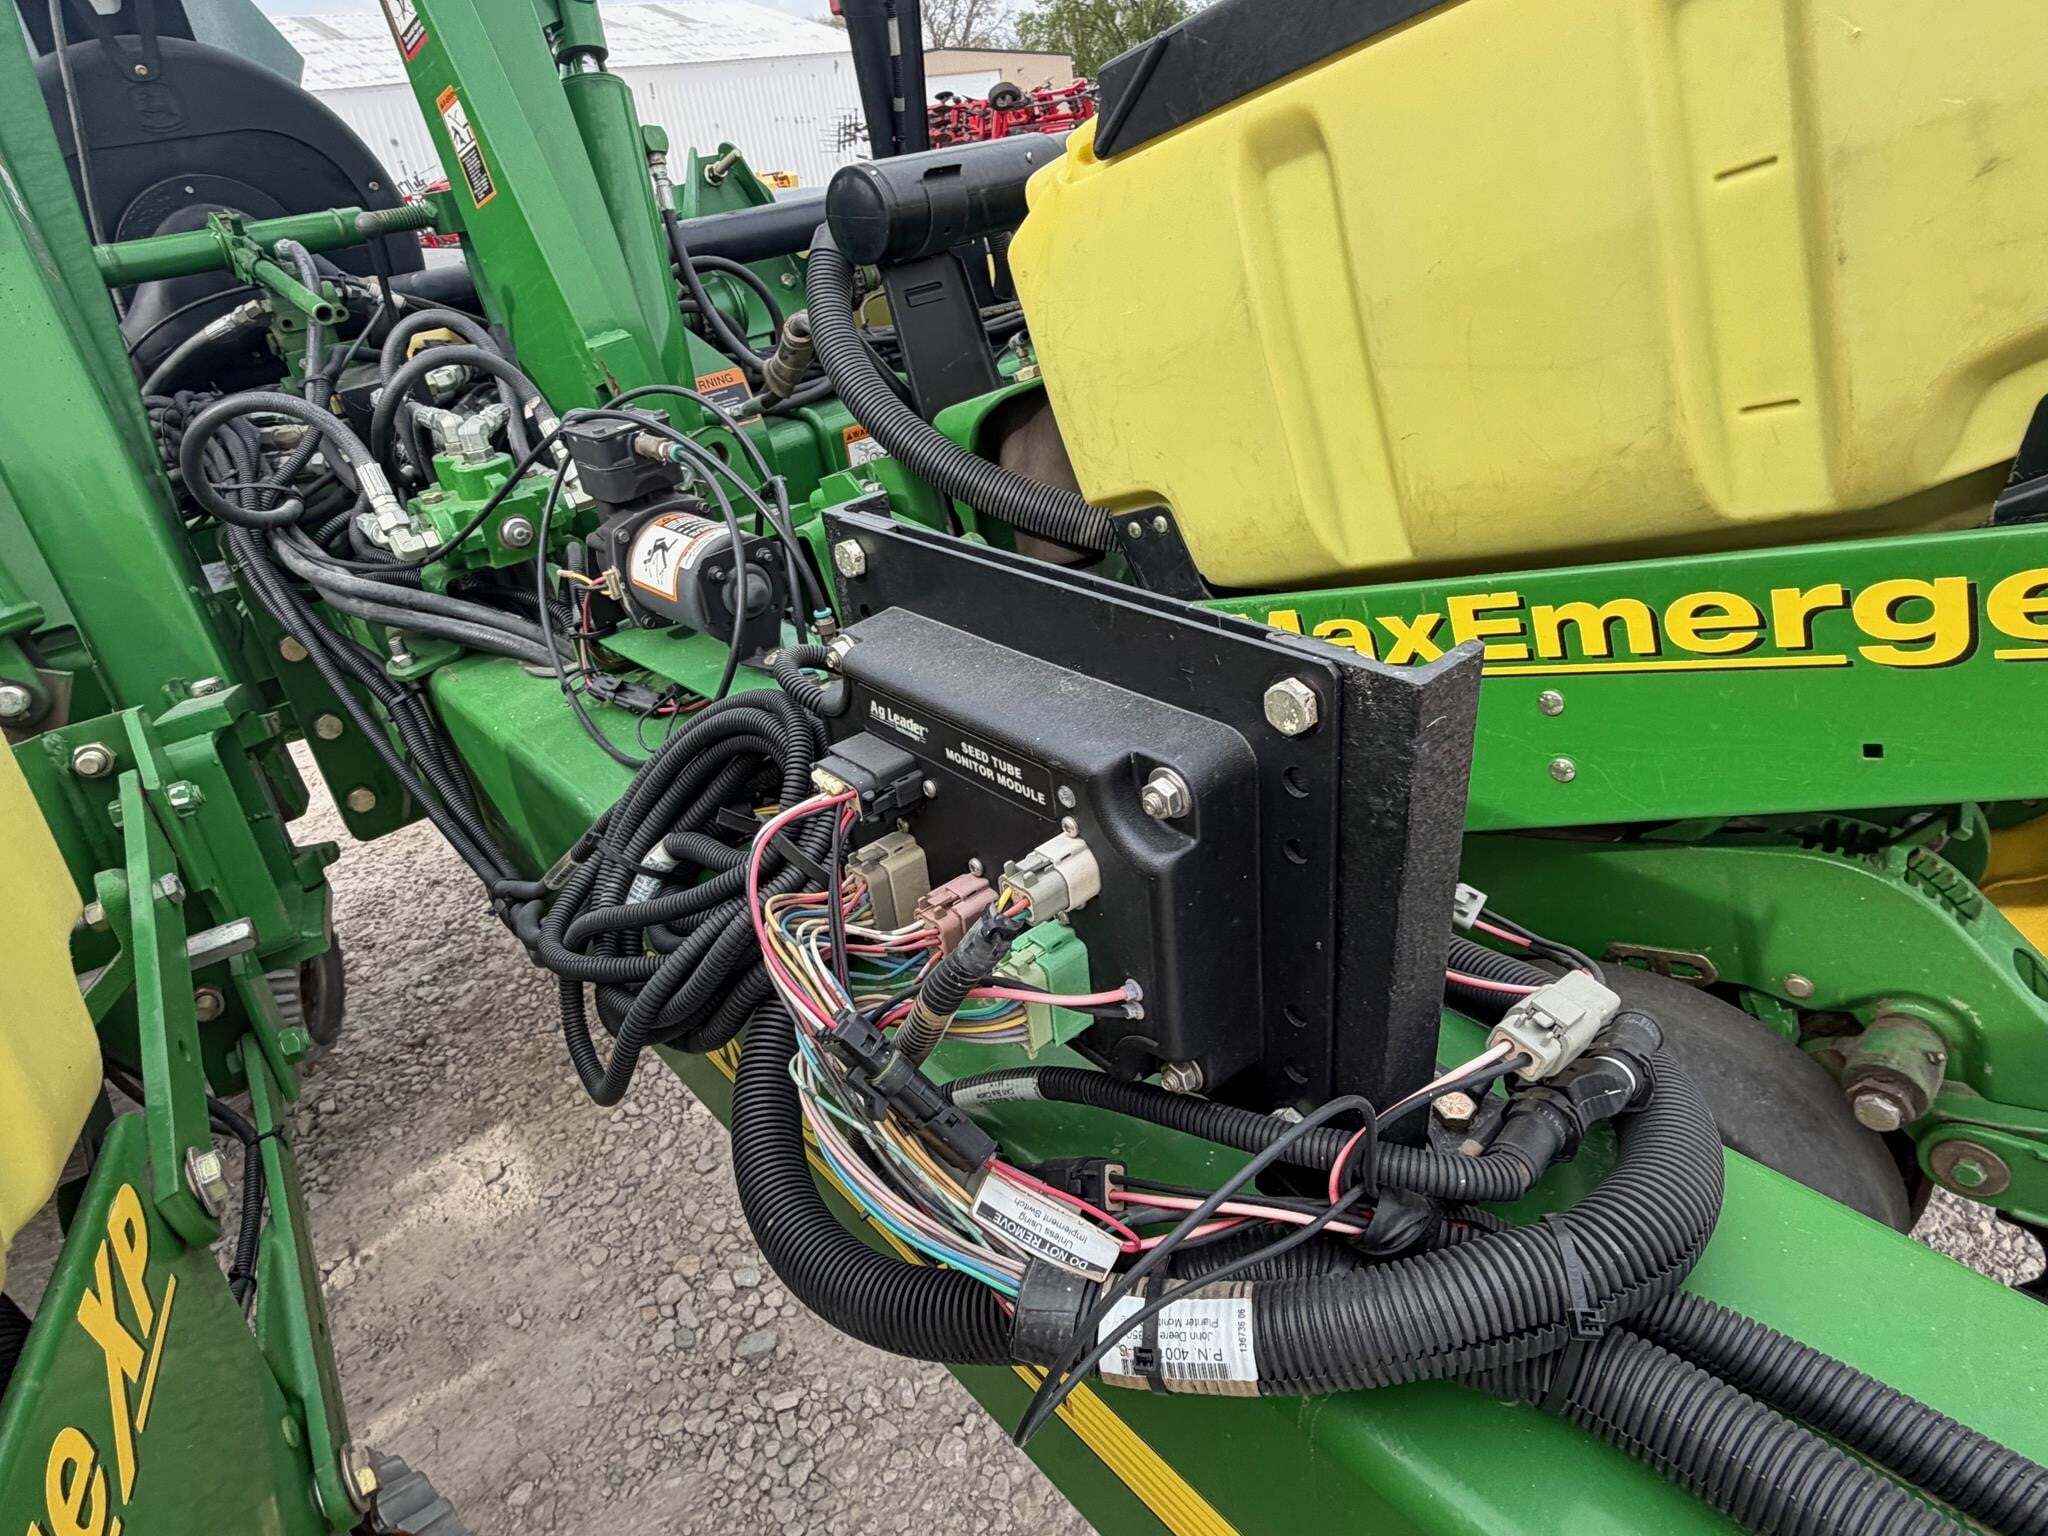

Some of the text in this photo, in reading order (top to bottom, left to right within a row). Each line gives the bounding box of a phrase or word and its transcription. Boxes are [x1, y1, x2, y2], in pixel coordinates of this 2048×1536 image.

[697, 372, 734, 391] RNING
[869, 699, 886, 721] Ag
[887, 706, 928, 736] Leader
[944, 747, 1047, 806] MONITOR MODULE
[960, 741, 1023, 780] SEED TUBE
[1013, 1197, 1088, 1244] Implement Switch
[1018, 1211, 1074, 1250] Unless Using
[992, 1211, 1089, 1270] DO NOT REMOVE
[1159, 1331, 1213, 1342] John Deere
[1186, 1317, 1219, 1329] Planter
